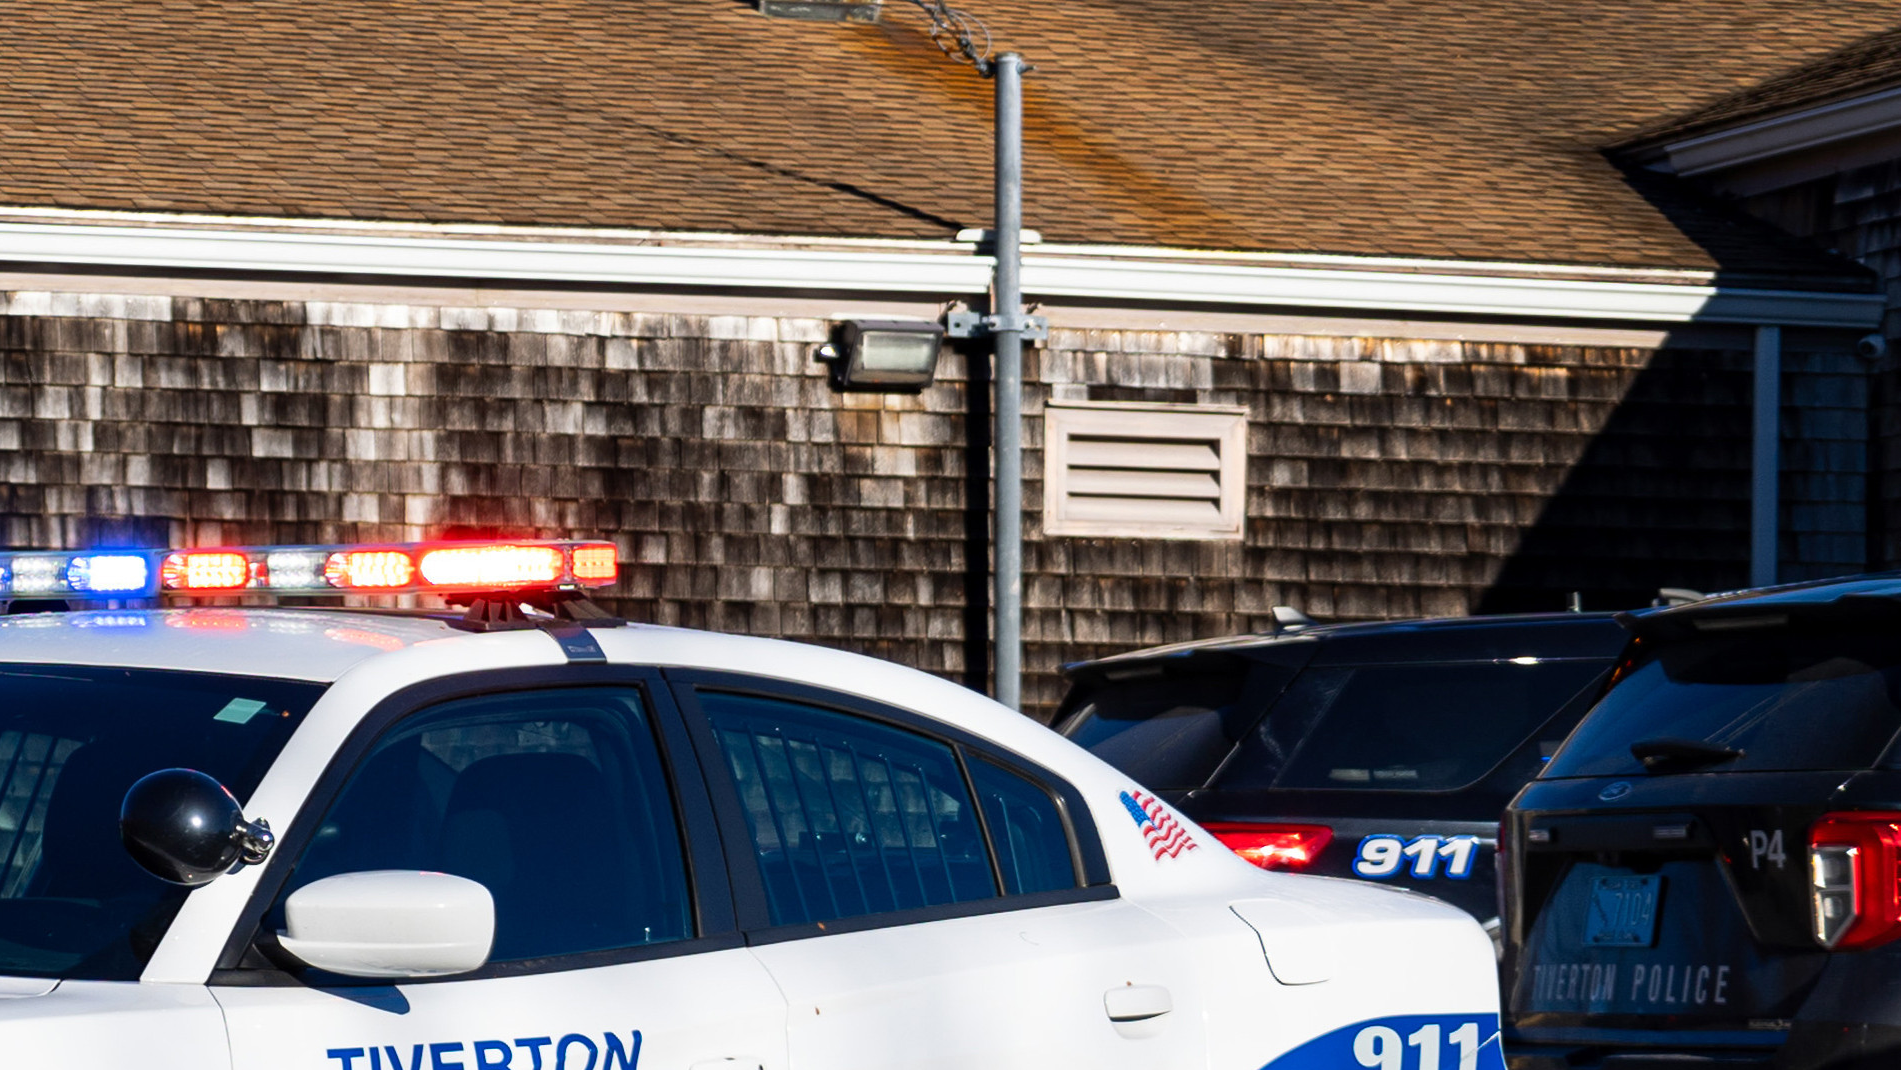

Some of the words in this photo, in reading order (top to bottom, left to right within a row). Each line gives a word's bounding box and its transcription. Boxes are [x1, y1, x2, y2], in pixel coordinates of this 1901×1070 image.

[1353, 834, 1479, 880] 911
[1750, 829, 1787, 870] P4
[1532, 963, 1618, 1002] TIVERTON
[1631, 964, 1731, 1005] POLICE
